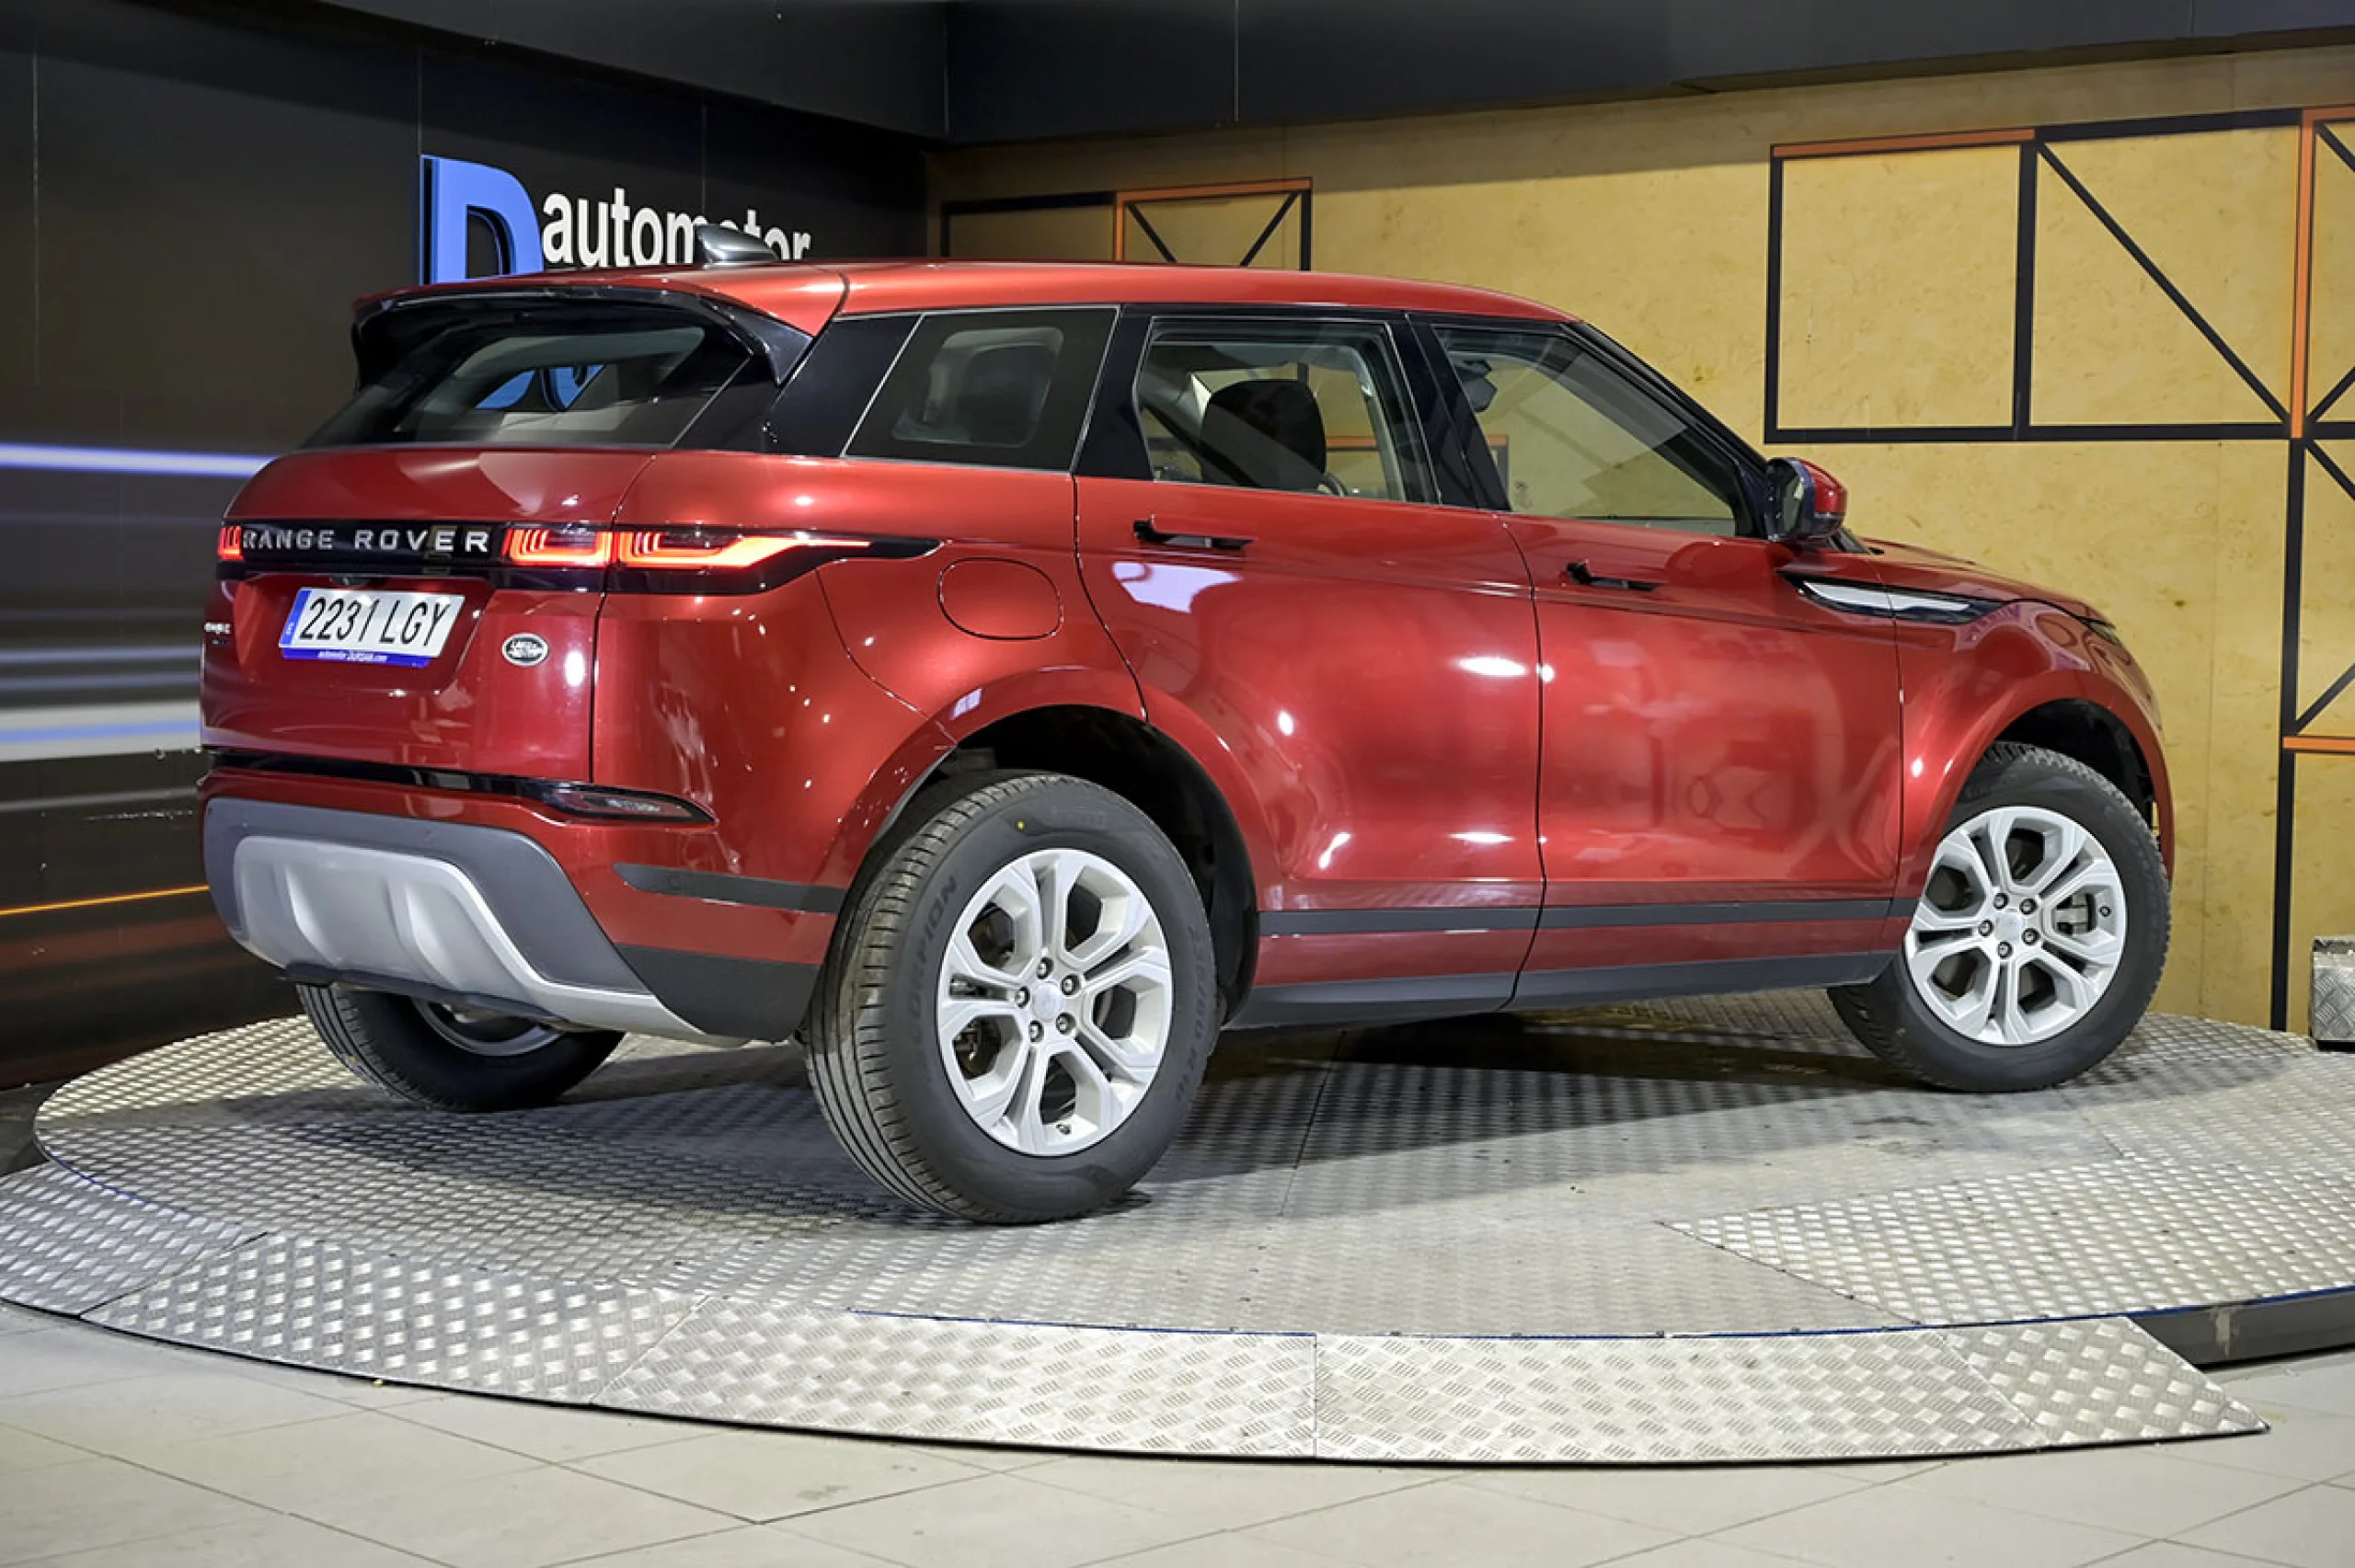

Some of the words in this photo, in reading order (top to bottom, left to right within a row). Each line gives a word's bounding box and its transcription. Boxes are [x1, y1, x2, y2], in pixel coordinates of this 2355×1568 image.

[543, 187, 811, 268] automtor
[242, 529, 335, 550] RANGE
[354, 529, 490, 553] ROVER
[299, 596, 382, 643] 2231
[378, 599, 452, 647] LGY
